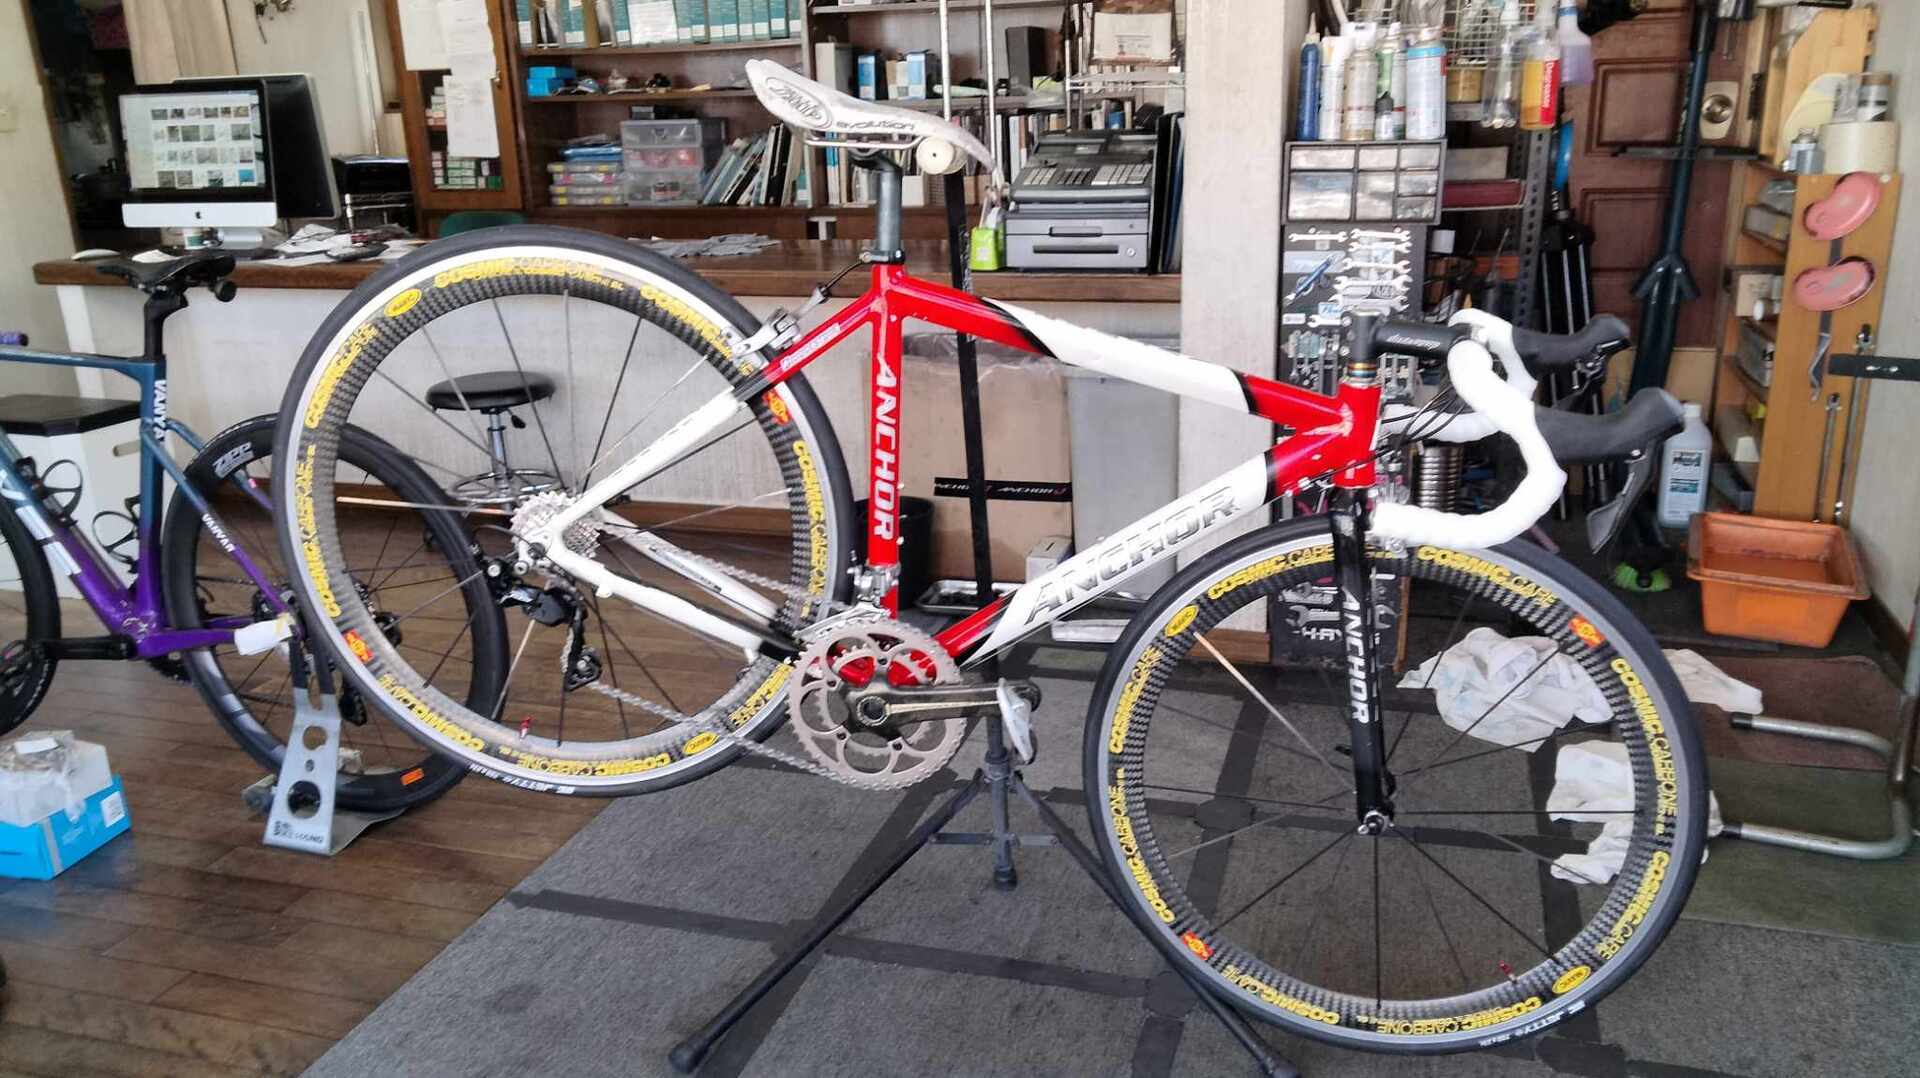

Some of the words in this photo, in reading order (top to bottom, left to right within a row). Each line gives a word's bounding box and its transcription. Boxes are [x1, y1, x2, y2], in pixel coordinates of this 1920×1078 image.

[836, 120, 915, 131] evolution
[154, 379, 167, 441] VANYA
[212, 442, 252, 468] ZIPP
[873, 355, 898, 541] ANCHOR
[997, 486, 1055, 495] ANCHOR
[1024, 486, 1242, 626] ANCHOR
[1207, 554, 1286, 600] COSMIC
[1417, 545, 1511, 582] COSMIC
[1342, 586, 1370, 724] ANCHOR
[1610, 657, 1665, 736] COSMIC
[1127, 856, 1176, 924] COSMIC
[1628, 850, 1671, 926] COSMIC
[1259, 988, 1341, 1026] COSMIC
[1376, 1020, 1461, 1036] CARBONE
[1461, 996, 1543, 1032] COSMIC
